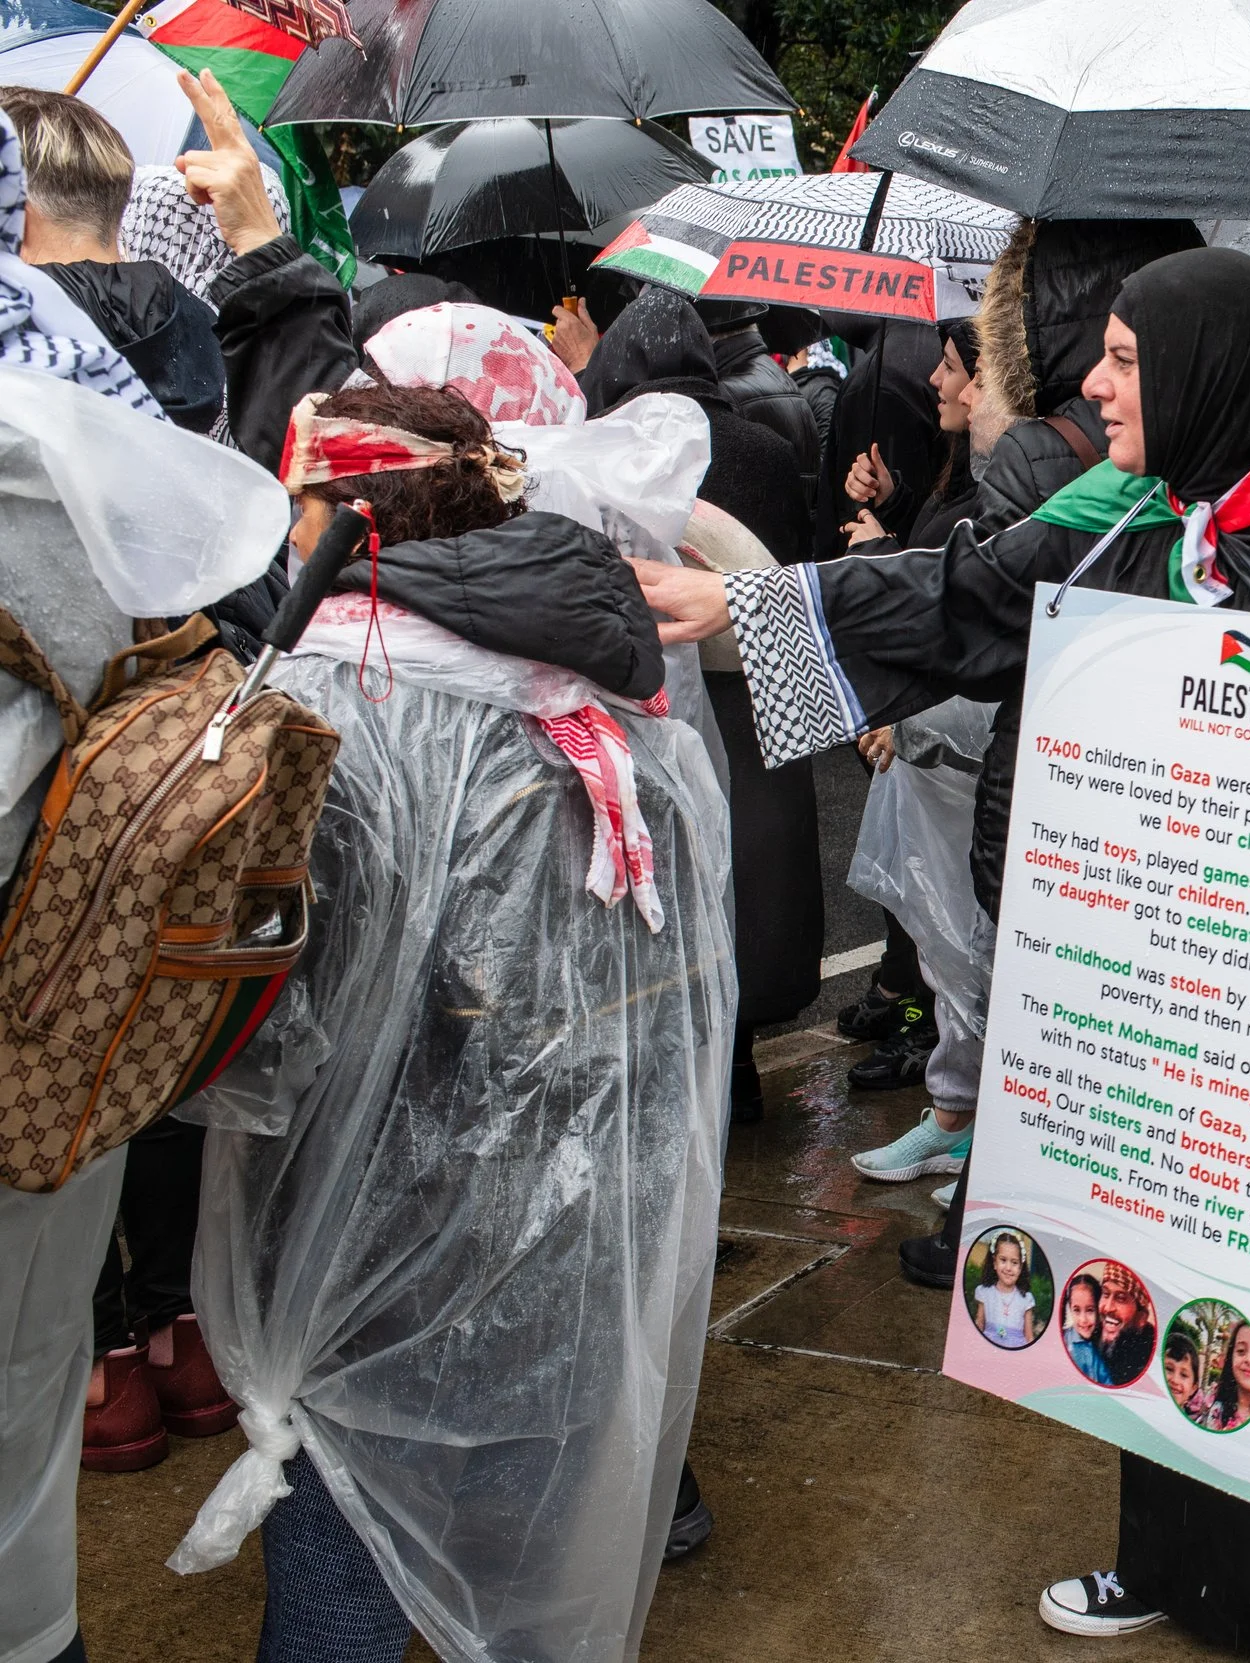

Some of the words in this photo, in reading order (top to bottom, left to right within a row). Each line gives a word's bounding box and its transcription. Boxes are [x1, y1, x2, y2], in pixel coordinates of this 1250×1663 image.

[705, 125, 776, 154] SAVE
[914, 138, 960, 159] LEXUS
[969, 155, 1009, 174] SUTHERLAND
[727, 254, 925, 300] PALESTINE
[1179, 717, 1205, 733] WILL
[1207, 722, 1232, 737] NOT
[1036, 736, 1081, 760] 17,400
[1085, 747, 1147, 774] children
[1151, 758, 1166, 778] in
[1170, 762, 1211, 787] Gaza
[1048, 763, 1084, 791] They
[1088, 776, 1125, 796] were
[1129, 780, 1173, 806] loved
[1177, 790, 1197, 815] by
[1201, 796, 1240, 820] their
[1031, 821, 1068, 849] They
[1071, 831, 1100, 853] had
[1103, 840, 1141, 866] toys,
[1146, 850, 1199, 876] played
[1139, 813, 1162, 830] we
[1166, 815, 1201, 839] love
[1205, 828, 1233, 845] our
[1025, 848, 1080, 875] clothes
[1083, 859, 1112, 883] just
[1116, 867, 1143, 890] like
[1146, 879, 1174, 897] our
[1178, 884, 1250, 916] children.
[1032, 877, 1056, 898] my
[1059, 881, 1130, 912] daughter
[1134, 902, 1161, 921] got
[1165, 908, 1183, 926] to
[1014, 929, 1052, 955] Their
[1055, 943, 1133, 977] childhood
[1136, 966, 1166, 986] was
[1169, 975, 1221, 1001] stolen
[1226, 986, 1247, 1011] by
[1149, 928, 1177, 952] but
[1181, 938, 1218, 965] they
[1021, 993, 1049, 1016] The
[1052, 1002, 1114, 1036] Prophet
[1117, 1021, 1199, 1060] Mohamad
[1203, 1049, 1236, 1070] said
[1100, 983, 1164, 1015] poverty,
[1168, 1002, 1199, 1022] and
[1204, 1009, 1241, 1034] then
[1040, 1027, 1072, 1049] with
[1076, 1039, 1096, 1056] no
[1100, 1046, 1147, 1071] status
[1190, 1067, 1204, 1088] is
[1001, 1048, 1025, 1071] We
[1028, 1061, 1052, 1079] are
[1055, 1068, 1073, 1086] all
[1077, 1073, 1103, 1095] the
[1106, 1083, 1174, 1117] children
[1178, 1106, 1196, 1123] of
[1199, 1109, 1247, 1143] Gaza,
[1003, 1075, 1051, 1108] blood,
[1056, 1092, 1086, 1116] Our
[1089, 1103, 1142, 1135] sisters
[1146, 1125, 1177, 1145] and
[1020, 1111, 1085, 1147] suffering
[1090, 1133, 1116, 1153] will
[1119, 1143, 1154, 1166] end.
[1160, 1152, 1184, 1175] No
[1189, 1163, 1240, 1194] doubt
[1040, 1141, 1123, 1183] victorious.
[1128, 1169, 1168, 1197] From
[1173, 1185, 1200, 1208] the
[1204, 1195, 1245, 1223] river
[1090, 1182, 1165, 1223] Palestine
[1170, 1214, 1197, 1235] will
[1201, 1221, 1222, 1243] be
